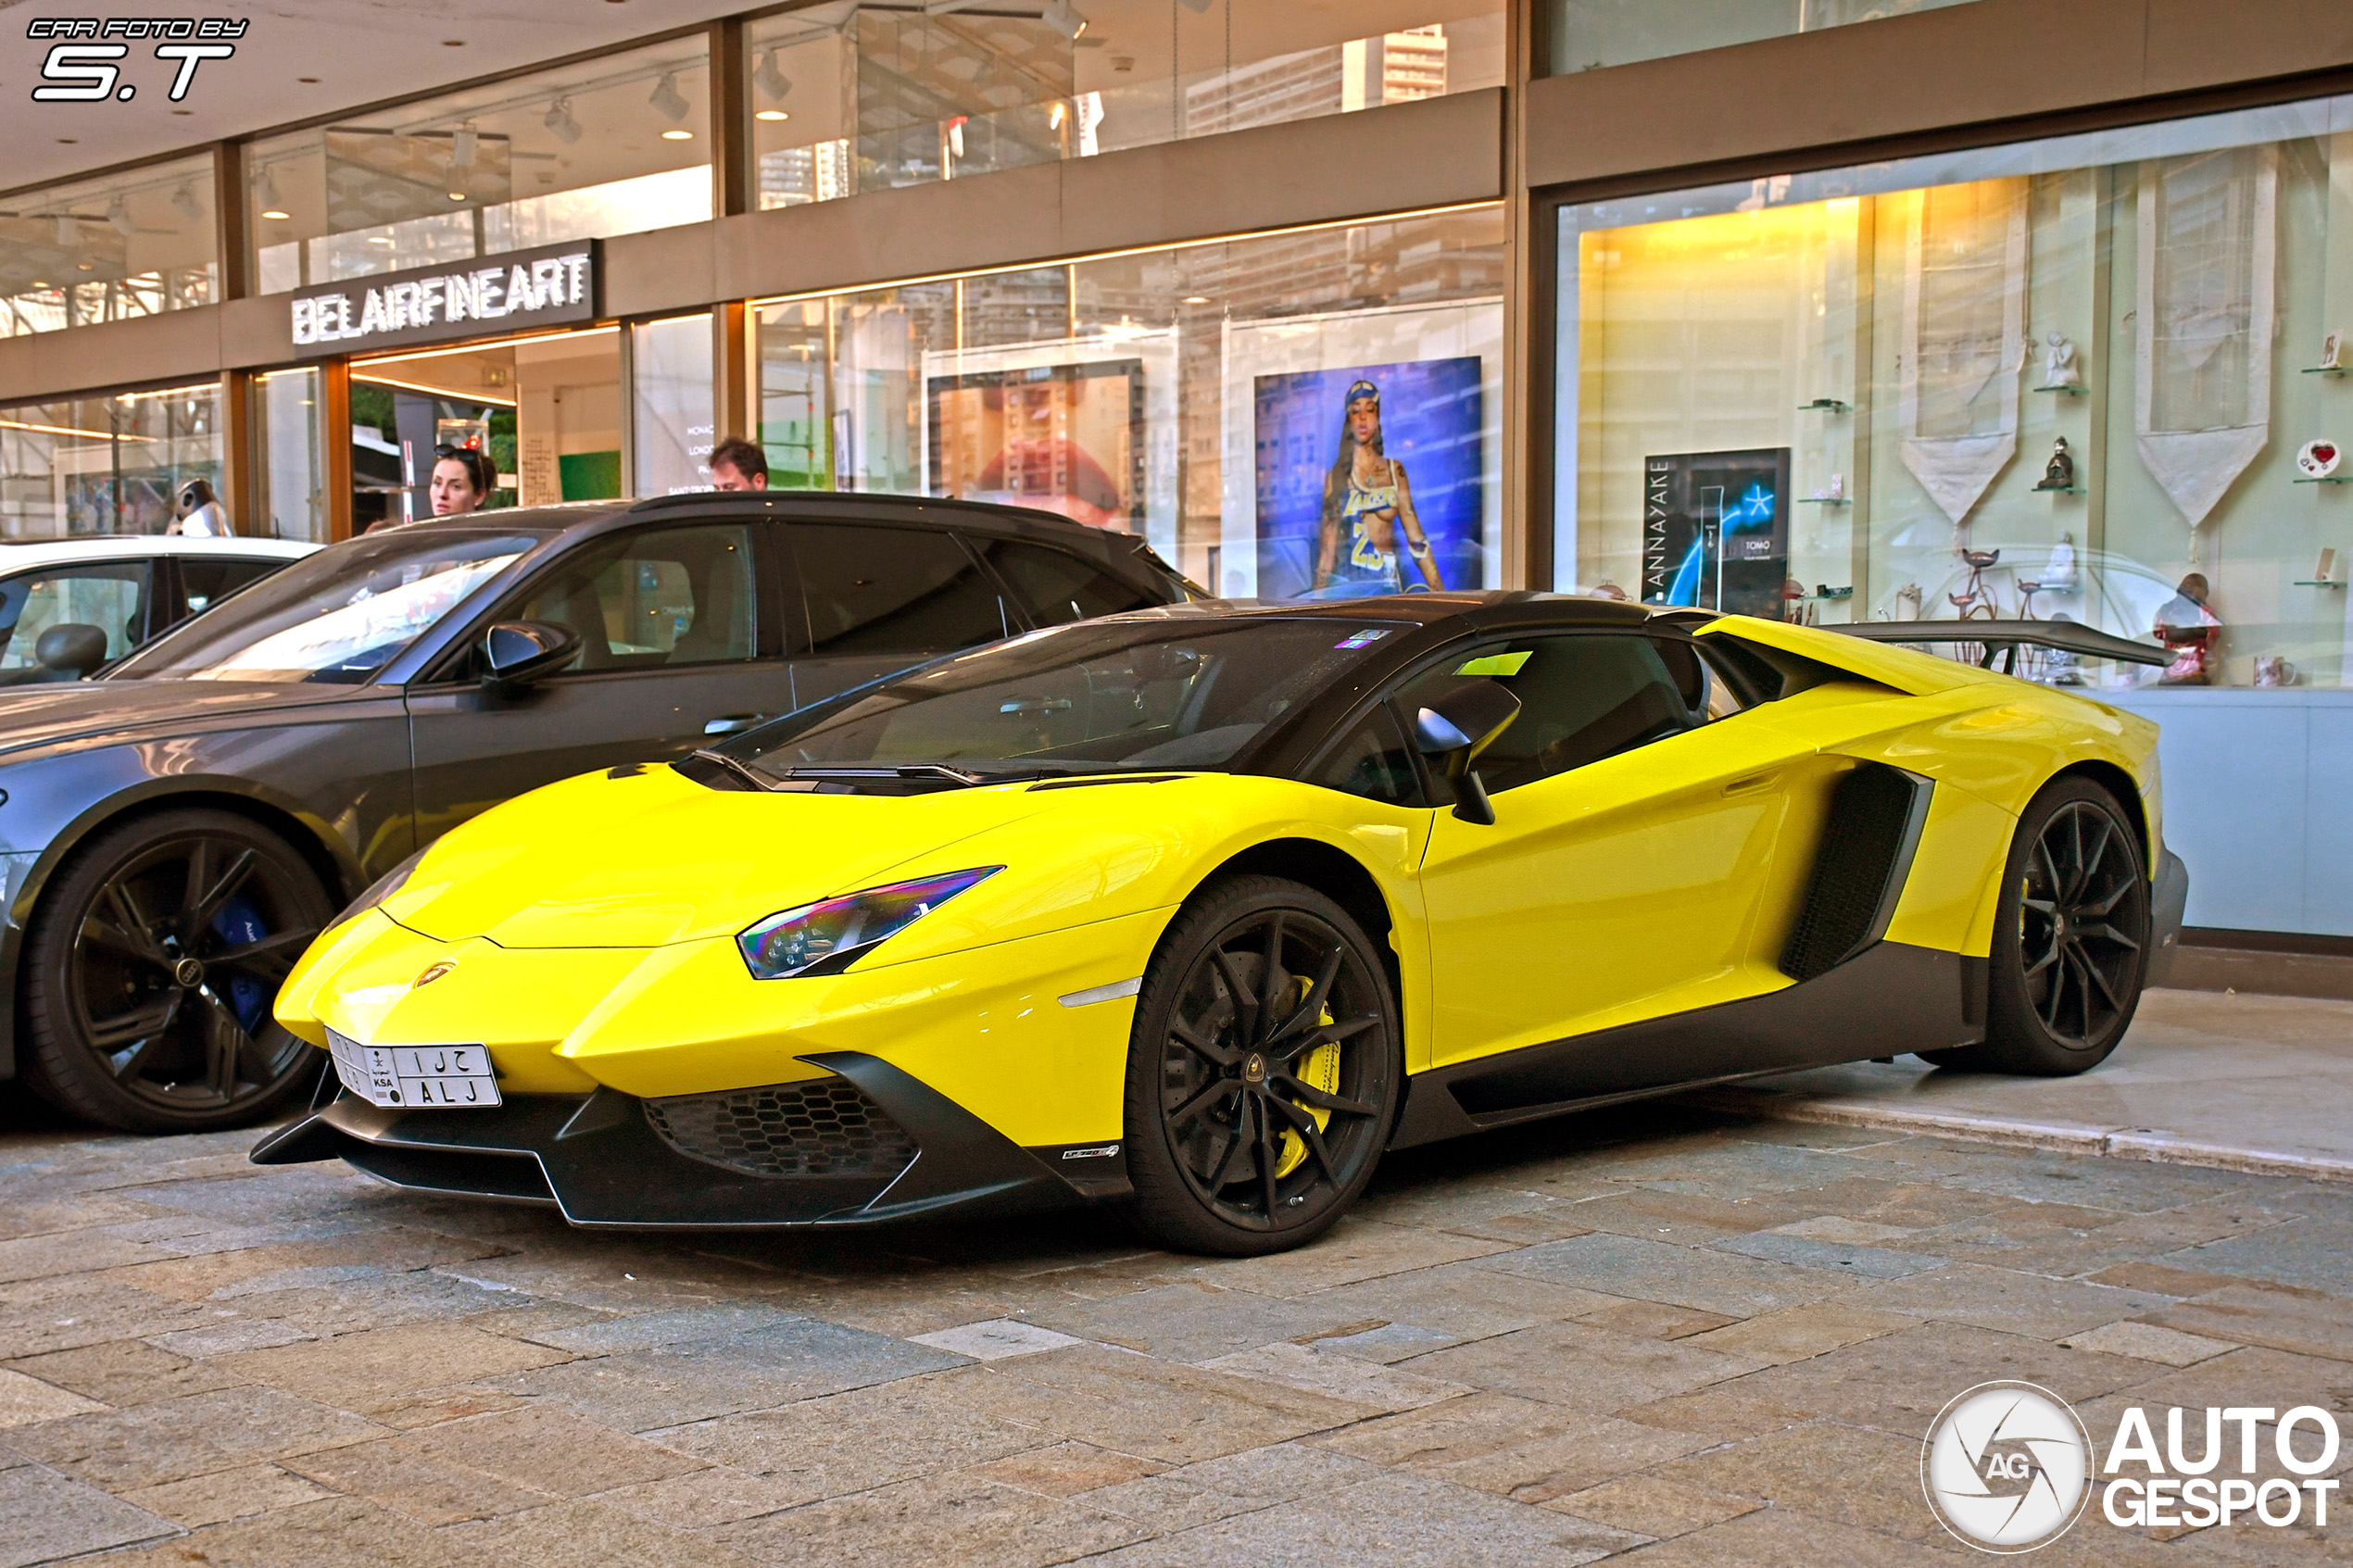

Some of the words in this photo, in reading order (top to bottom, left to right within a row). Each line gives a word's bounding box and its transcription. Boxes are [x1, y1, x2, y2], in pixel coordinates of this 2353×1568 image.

[687, 425, 714, 435] MONAC
[689, 445, 714, 456] LONDO
[1647, 461, 1668, 587] ANNAYAKE
[245, 922, 258, 942] Aud
[373, 1078, 394, 1087] KSA
